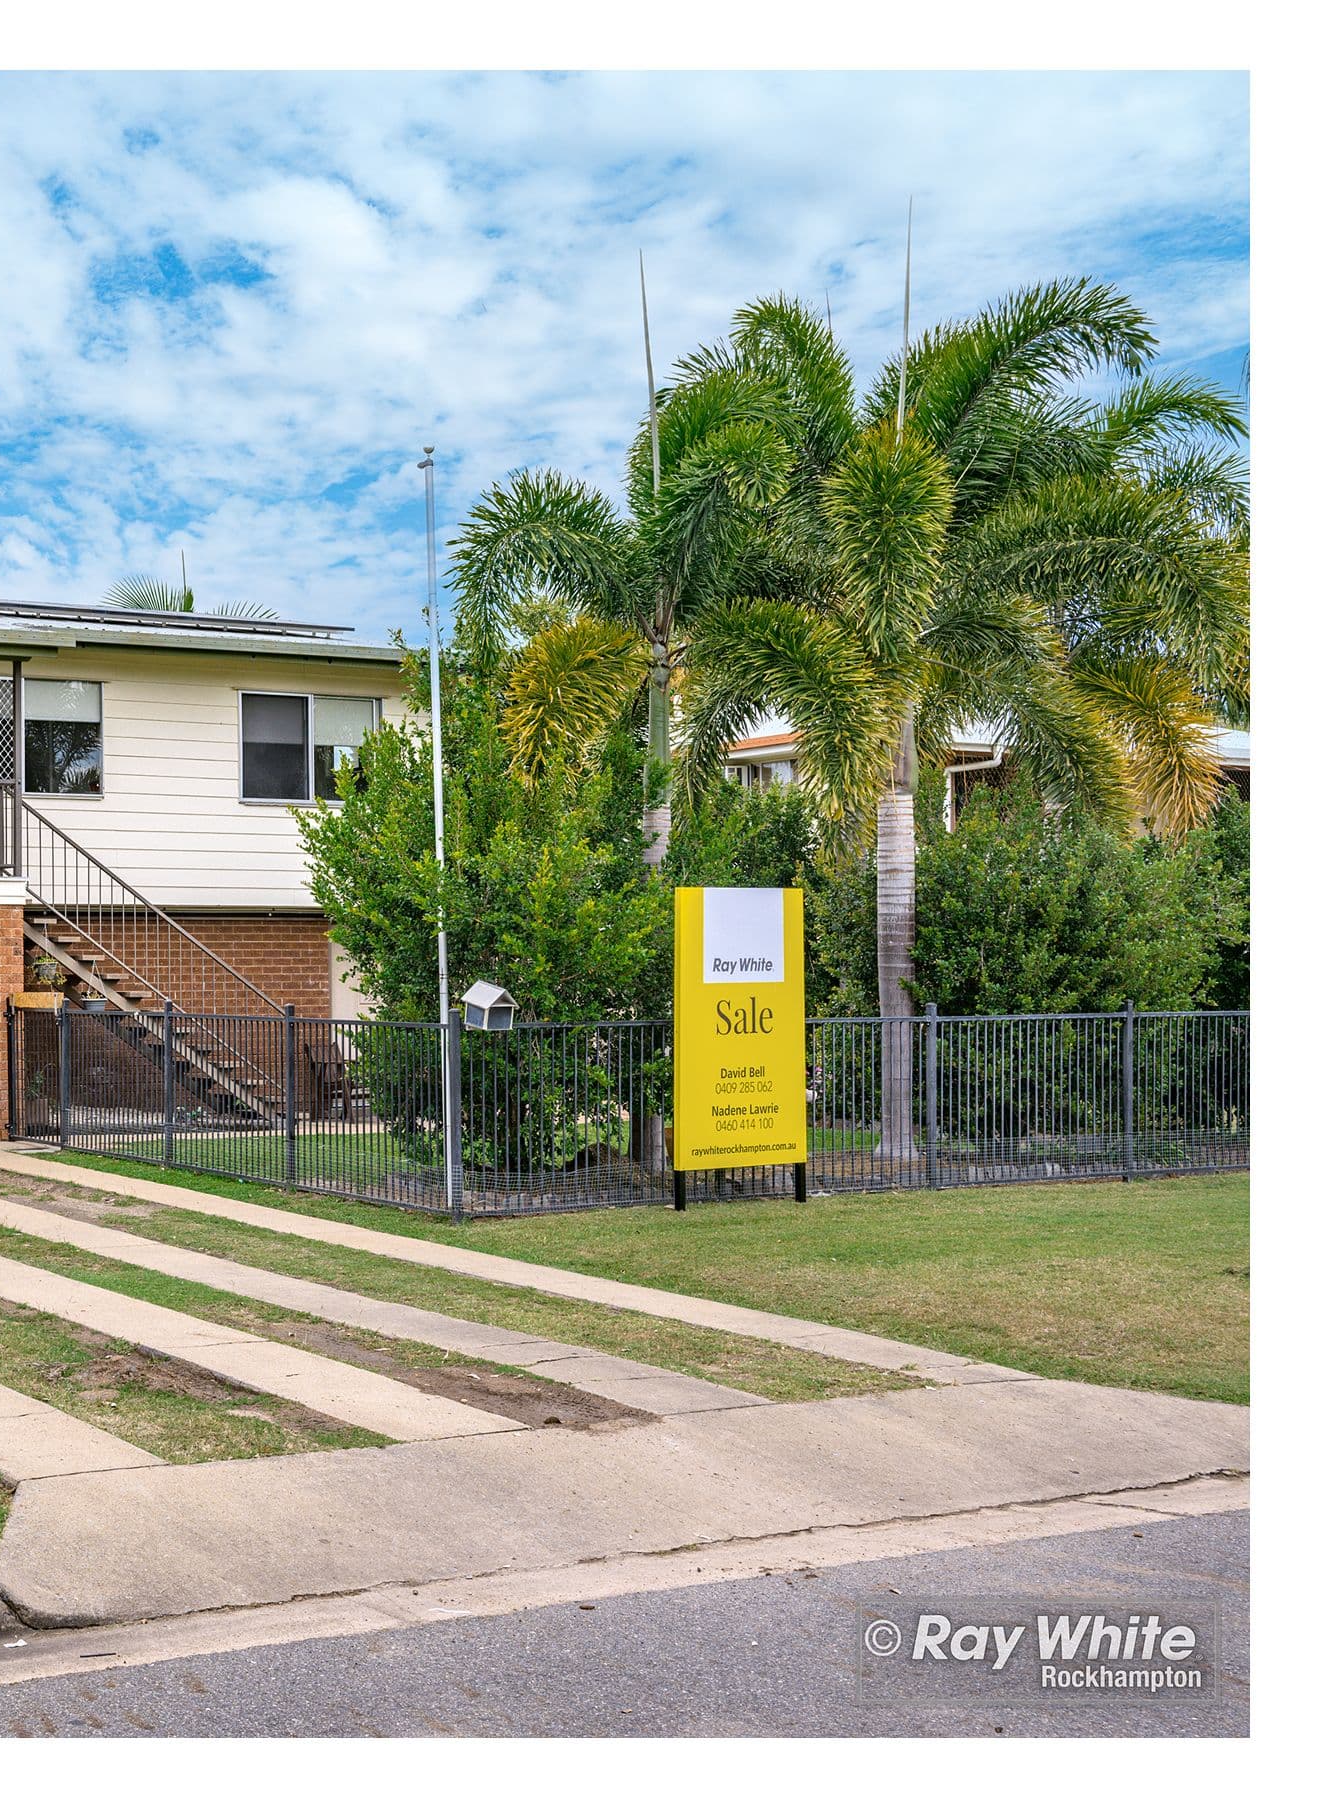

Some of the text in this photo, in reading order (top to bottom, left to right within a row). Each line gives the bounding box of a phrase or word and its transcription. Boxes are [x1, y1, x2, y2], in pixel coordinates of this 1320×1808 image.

[712, 957, 773, 975] Ray White
[716, 996, 774, 1036] Sale
[720, 1066, 765, 1079] David Bell
[715, 1080, 773, 1095] 0409 285 062
[711, 1103, 779, 1117] Nadene Lawrie
[715, 1117, 774, 1132] 0460 414 100
[691, 1142, 797, 1157] raywhiterockhampton.com.au
